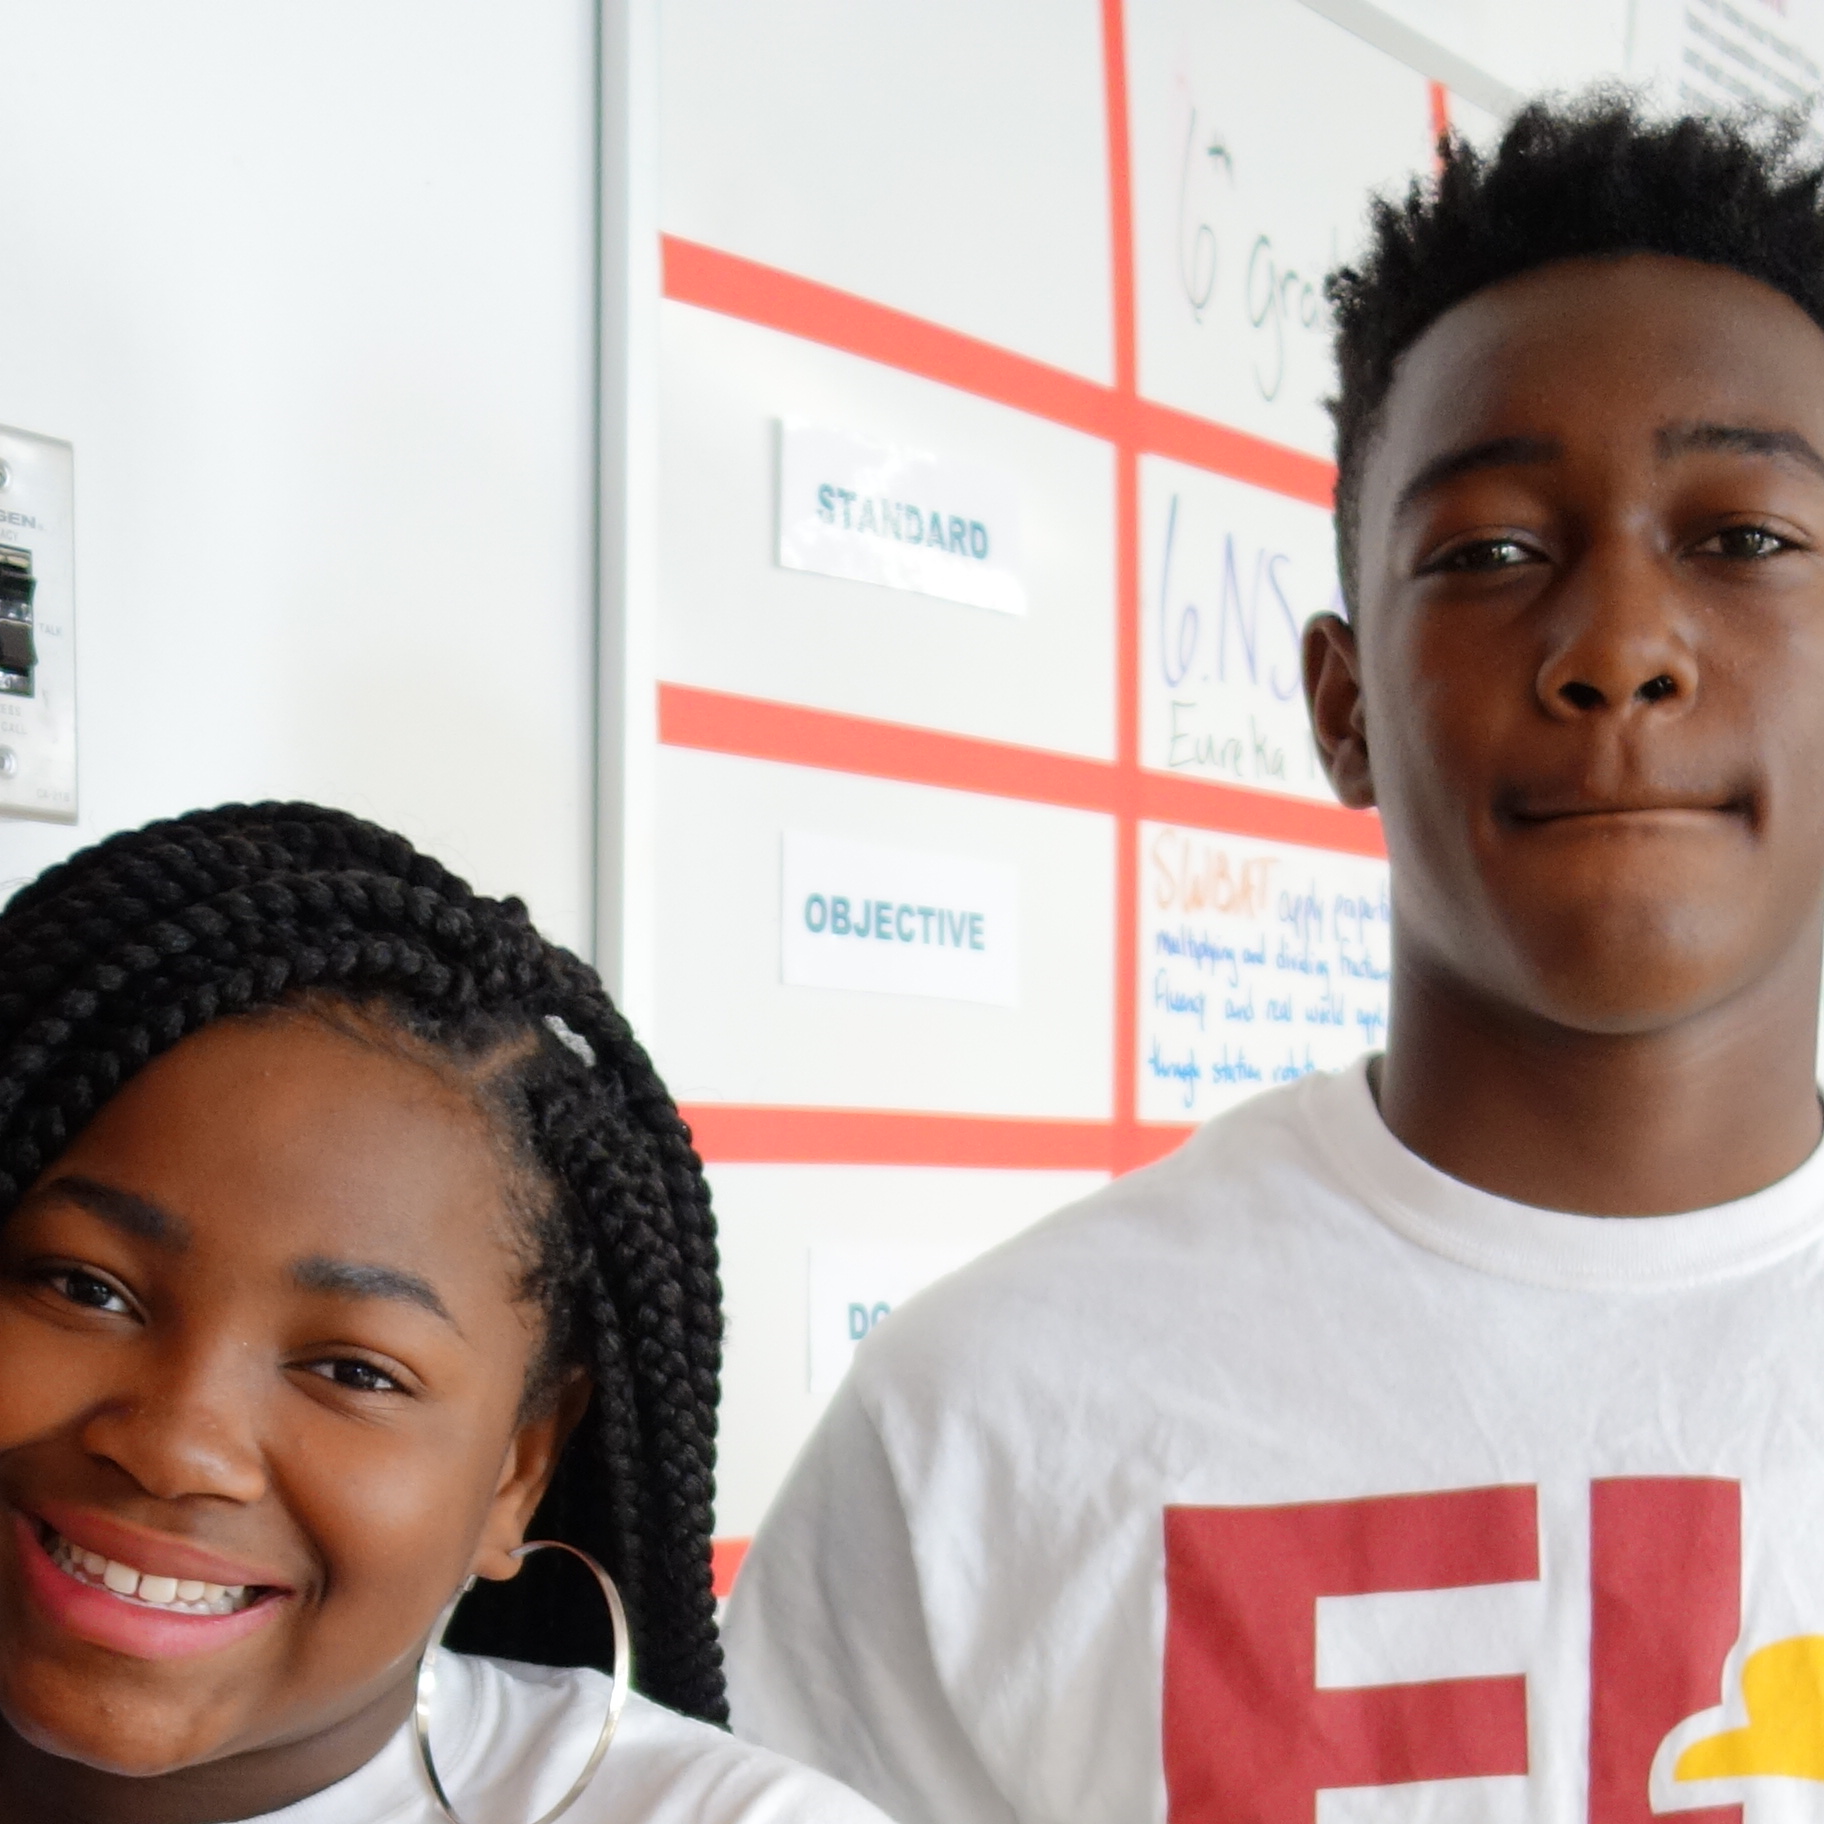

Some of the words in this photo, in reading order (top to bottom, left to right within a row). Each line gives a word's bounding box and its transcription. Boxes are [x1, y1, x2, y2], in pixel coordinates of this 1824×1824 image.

[816, 482, 991, 561] STANDARD
[36, 622, 63, 637] TALK
[1, 721, 29, 736] CALL
[1168, 700, 1288, 781] Eureka
[1151, 827, 1280, 918] SWBAT
[803, 891, 986, 951] OBJECTIVE
